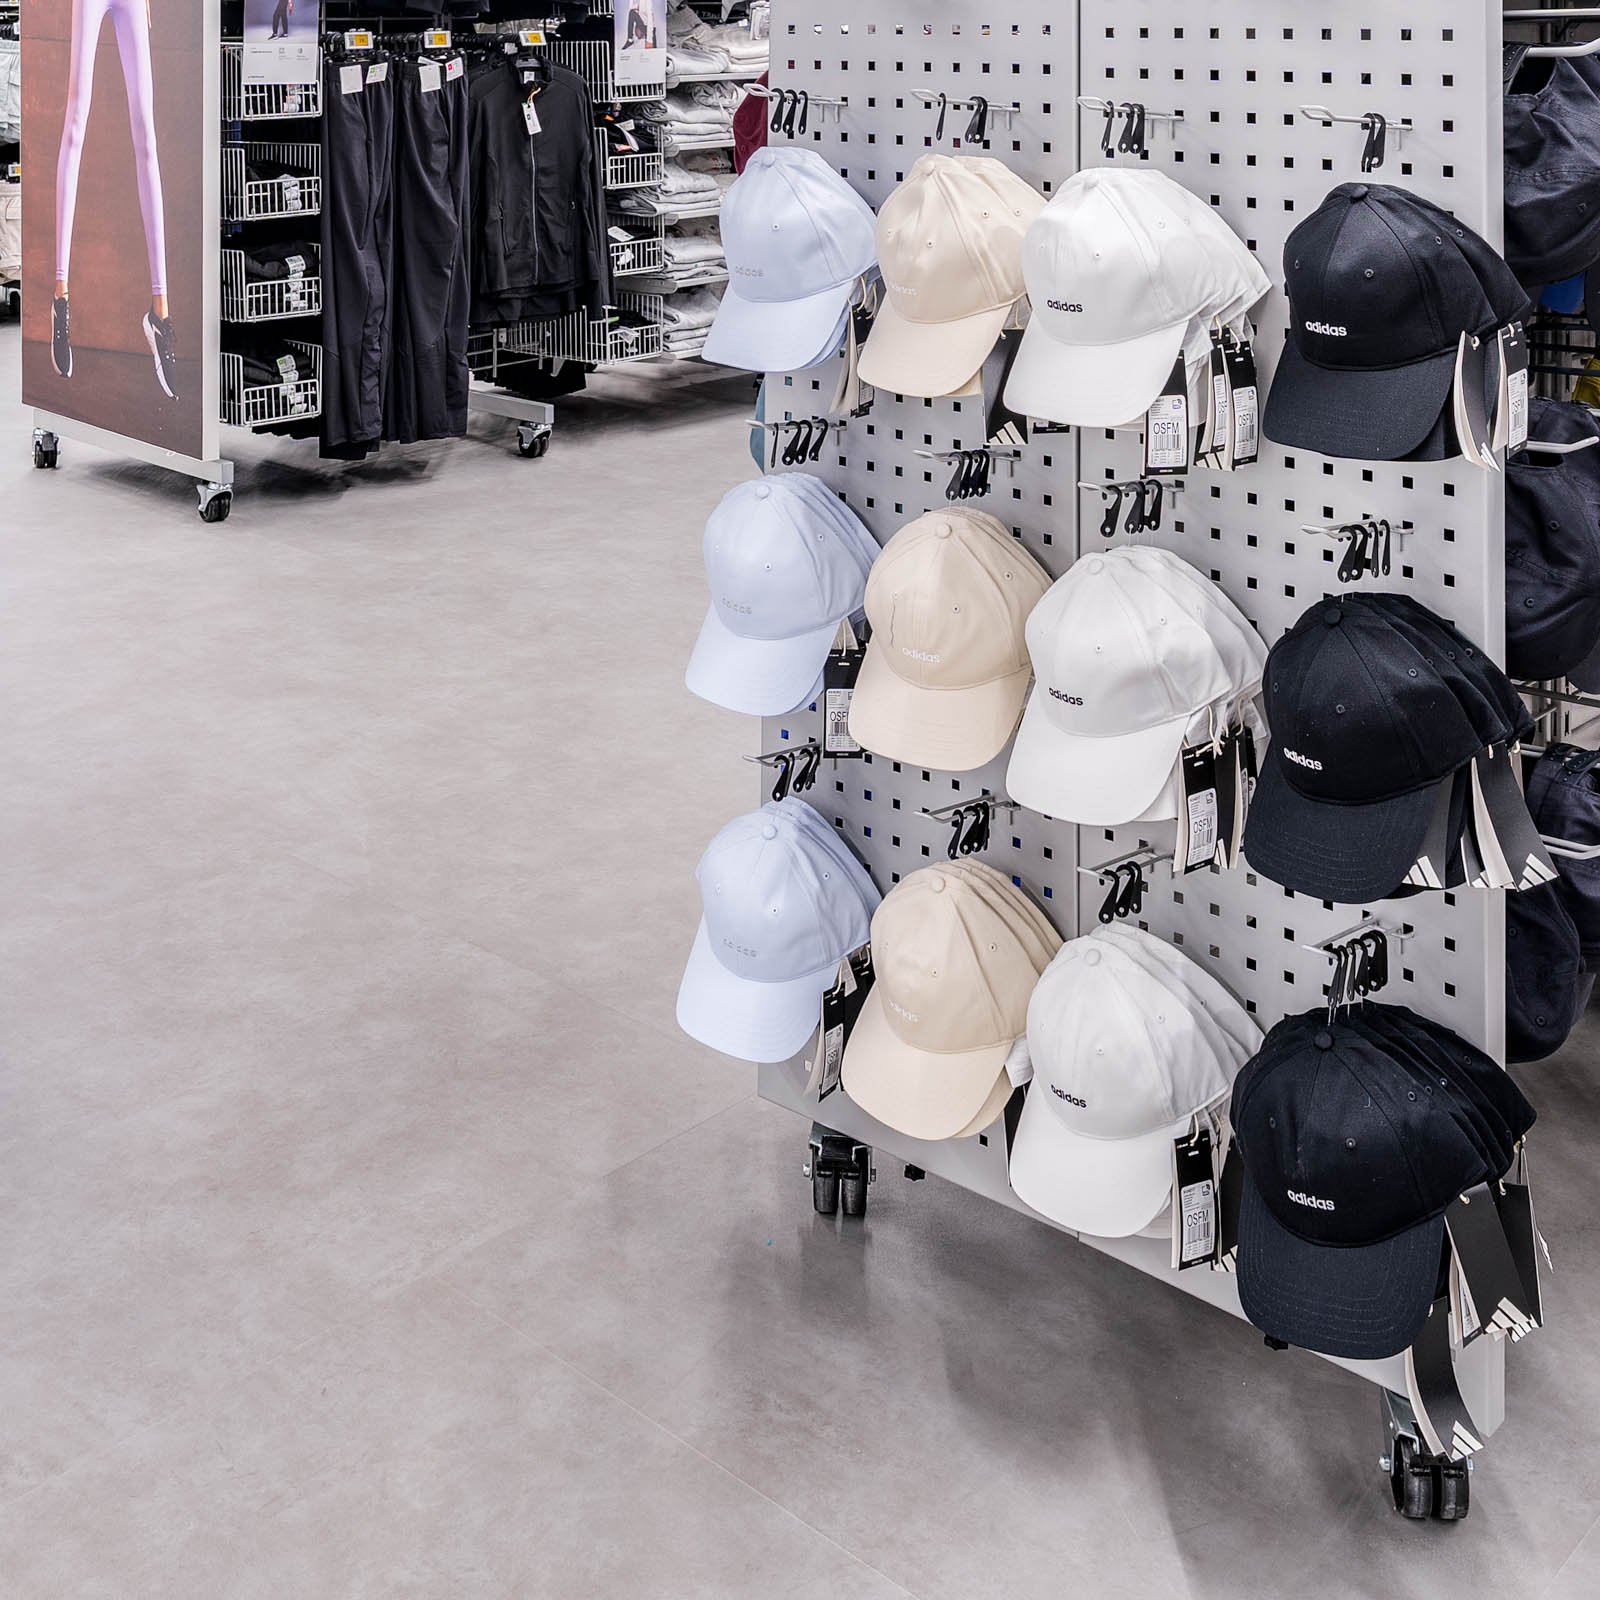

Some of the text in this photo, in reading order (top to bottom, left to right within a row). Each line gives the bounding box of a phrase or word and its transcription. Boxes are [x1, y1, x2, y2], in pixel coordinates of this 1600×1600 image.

[1047, 298, 1084, 314] adidas
[1305, 320, 1348, 338] adidas
[1153, 422, 1181, 435] OSFM
[902, 647, 942, 664] adidas
[1048, 687, 1084, 706] adidas
[830, 711, 849, 722] OSF
[1283, 747, 1324, 771] adidas
[1193, 817, 1213, 834] OSFM
[1050, 1084, 1088, 1109] adidas
[1287, 1189, 1336, 1212] adidas
[1186, 1210, 1210, 1228] OSFM
